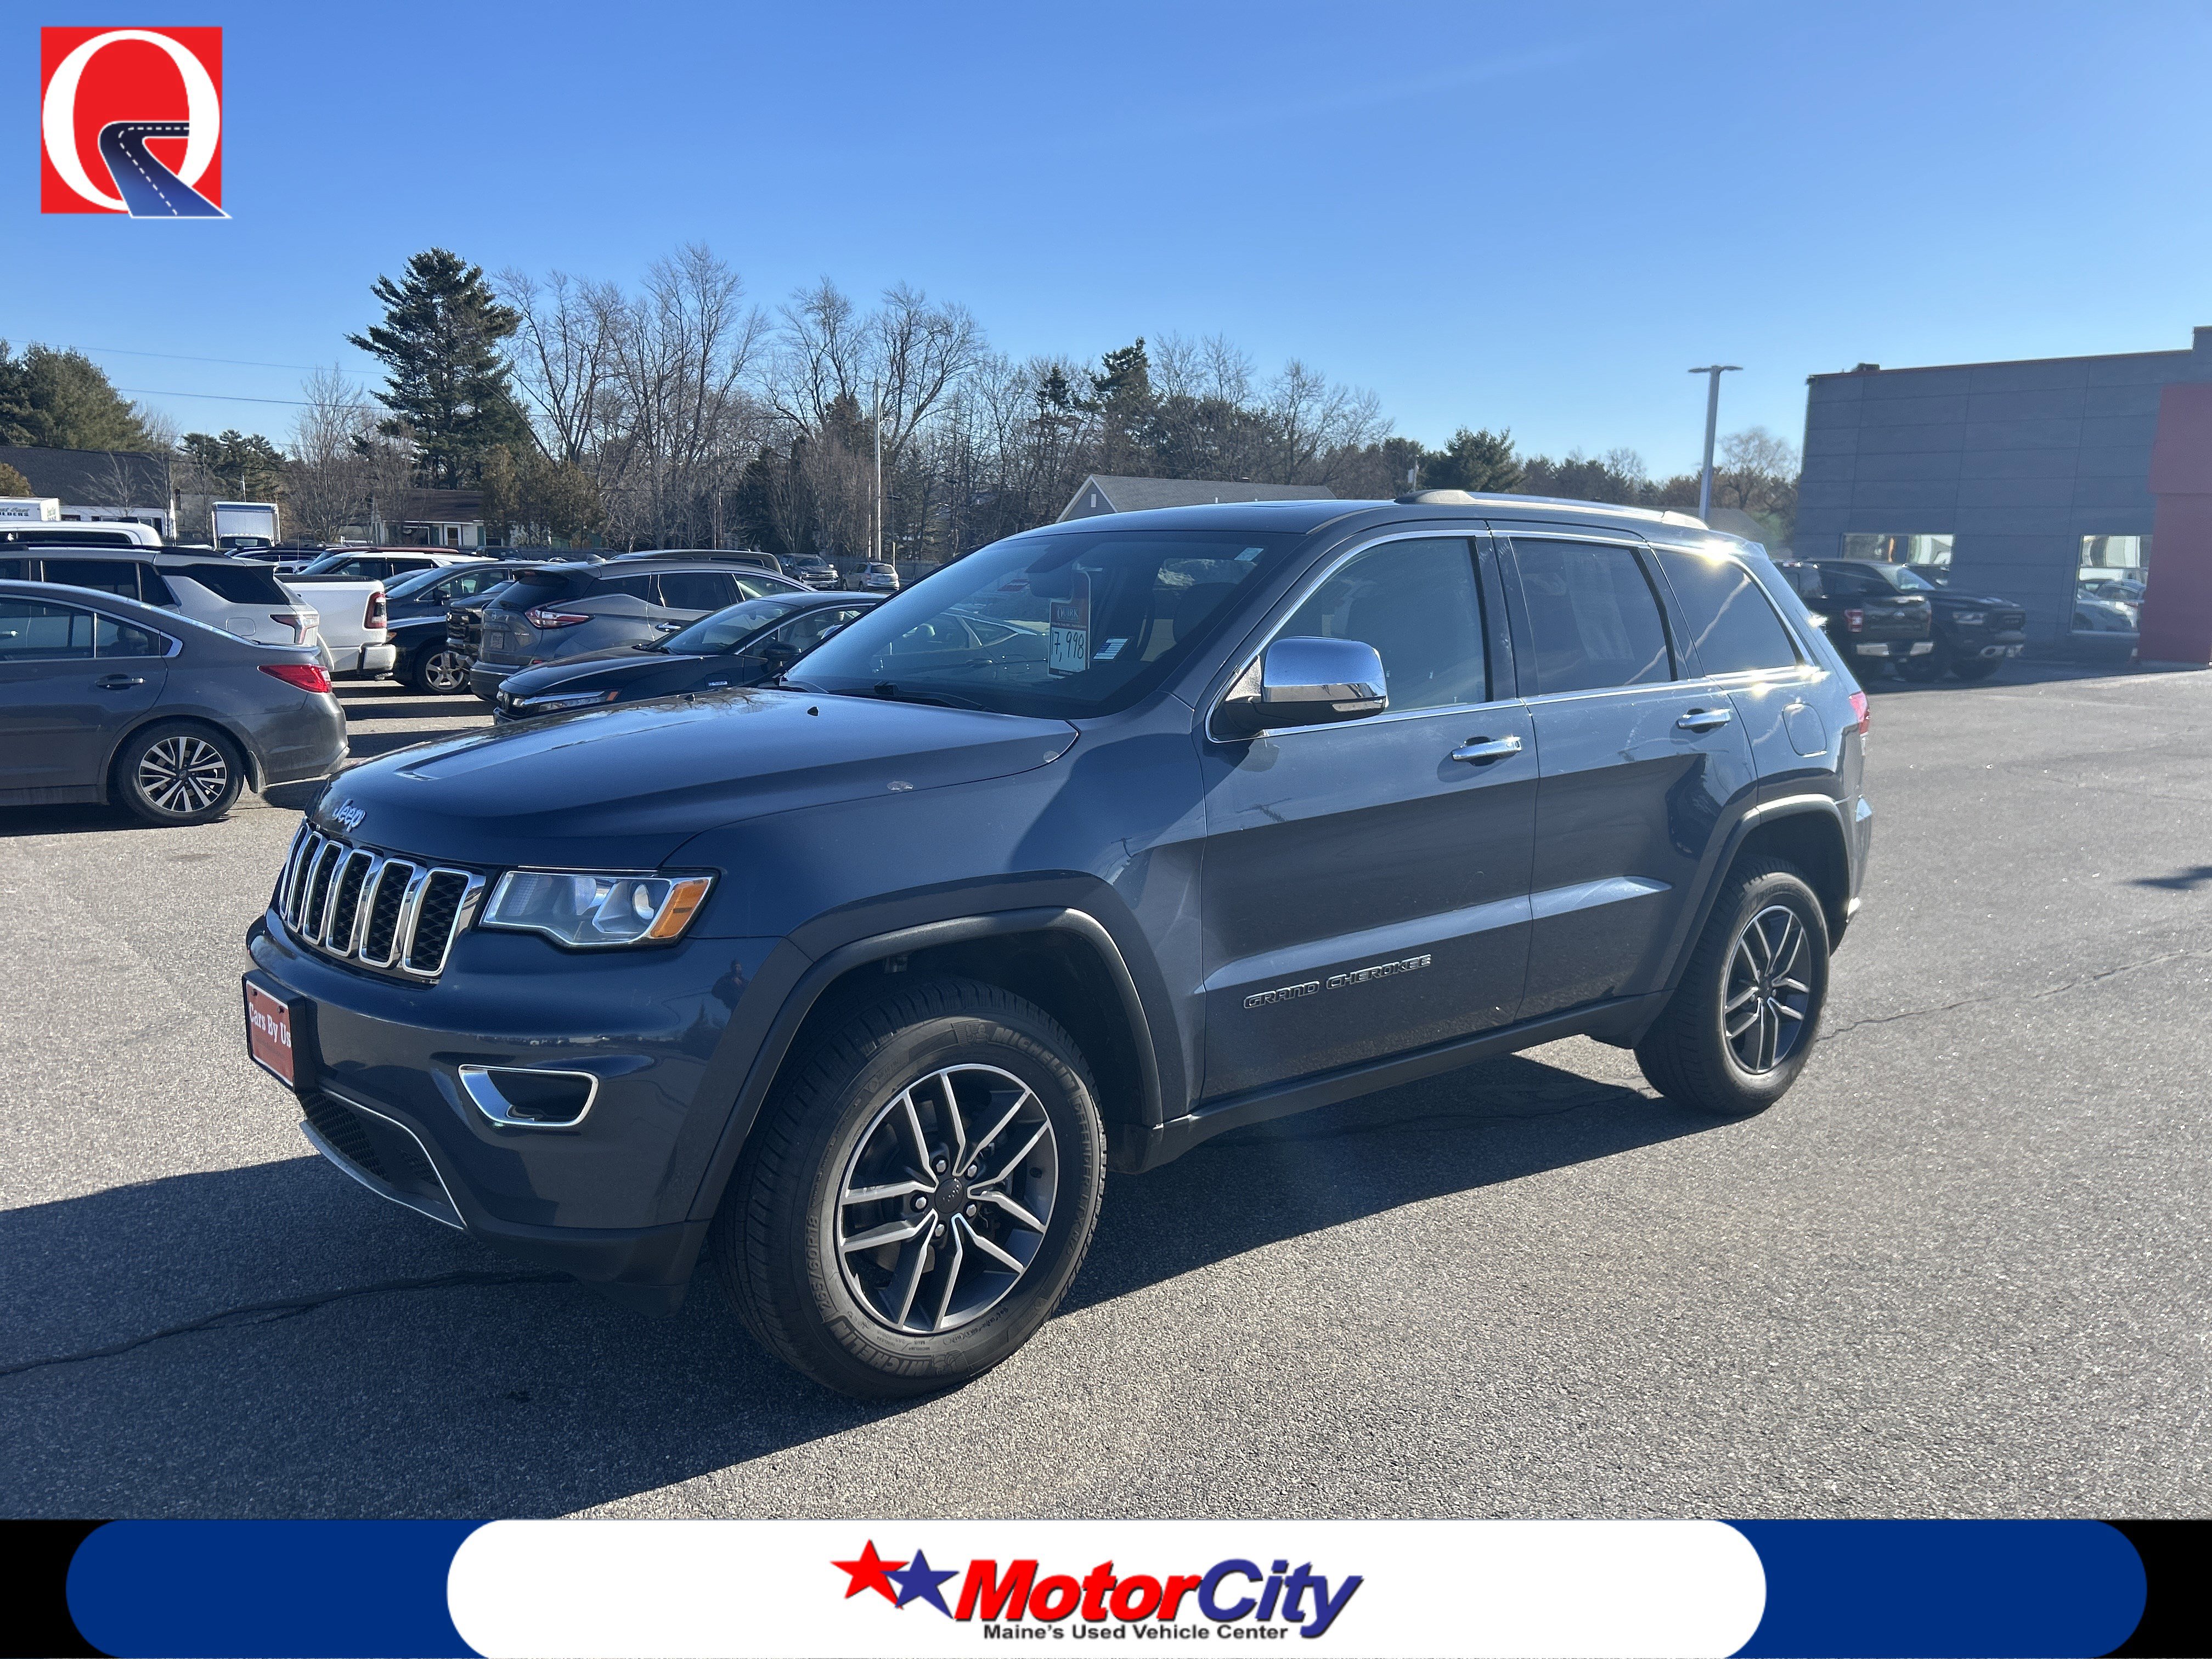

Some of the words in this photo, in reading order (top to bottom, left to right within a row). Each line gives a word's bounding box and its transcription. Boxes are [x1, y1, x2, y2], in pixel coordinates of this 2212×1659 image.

[1057, 607, 1079, 619] QUIRK
[1051, 631, 1085, 663] 17,998
[331, 798, 366, 832] Jeep
[1243, 980, 1320, 1009] GRAND
[1326, 954, 1431, 989] CHEROKEE
[249, 1002, 266, 1031] Cars
[267, 1014, 278, 1043] By
[280, 1022, 291, 1048] Us
[992, 1026, 1076, 1091] MICHELIN
[1073, 1099, 1093, 1185] DEFENDER
[806, 1215, 831, 1311] 265/60R18
[829, 1321, 930, 1376] MICHELIN
